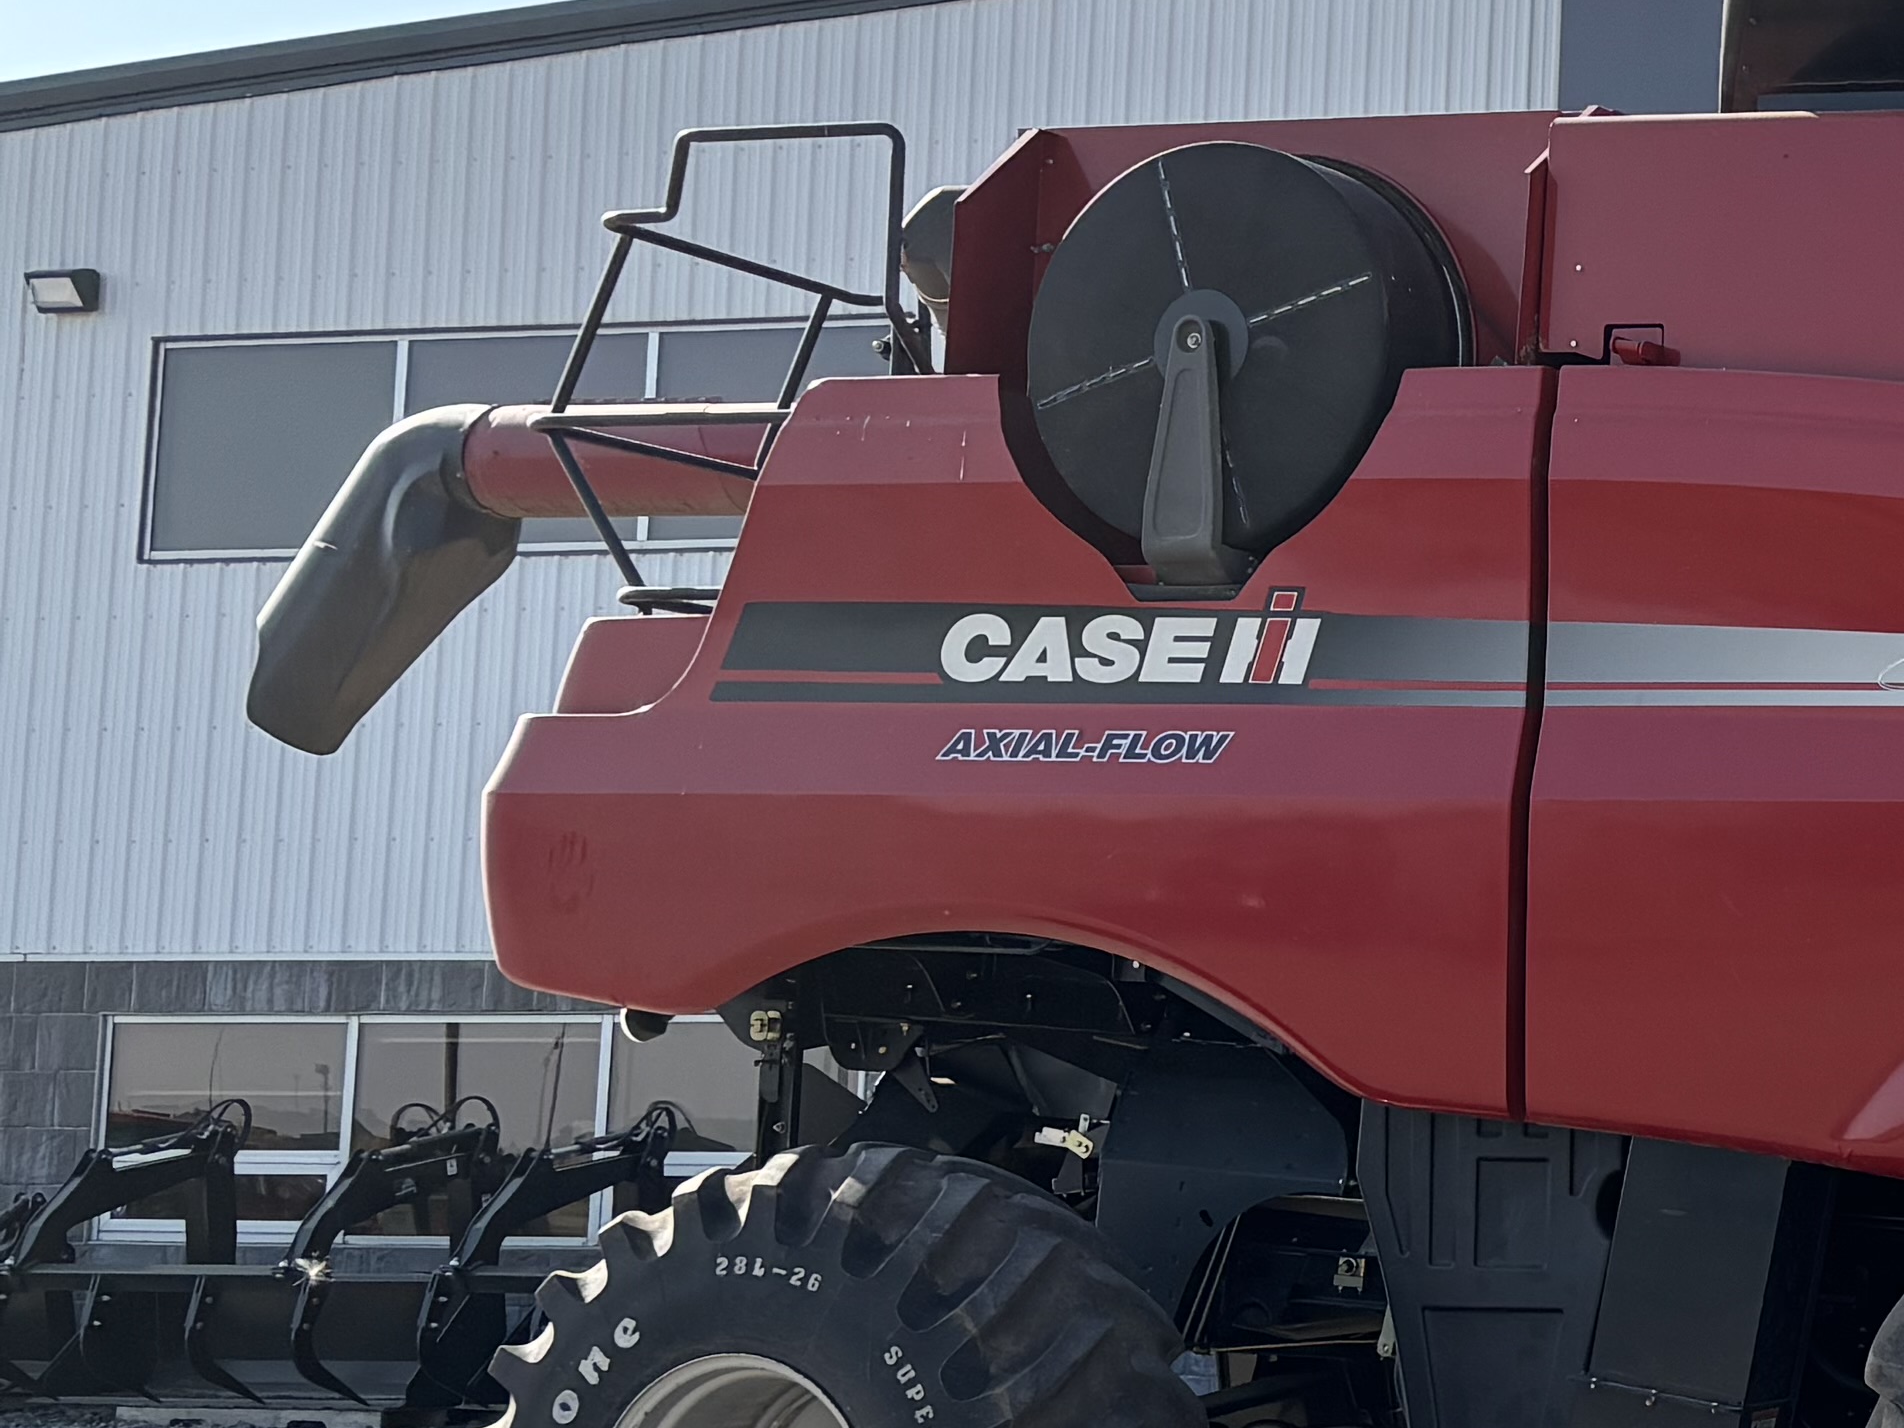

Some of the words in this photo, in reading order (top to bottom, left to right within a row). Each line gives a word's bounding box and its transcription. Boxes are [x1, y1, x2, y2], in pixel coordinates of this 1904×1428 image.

[940, 613, 1218, 683] CASE
[936, 729, 1234, 763] AXIAL-FLOW
[715, 1256, 822, 1292] 28L-26
